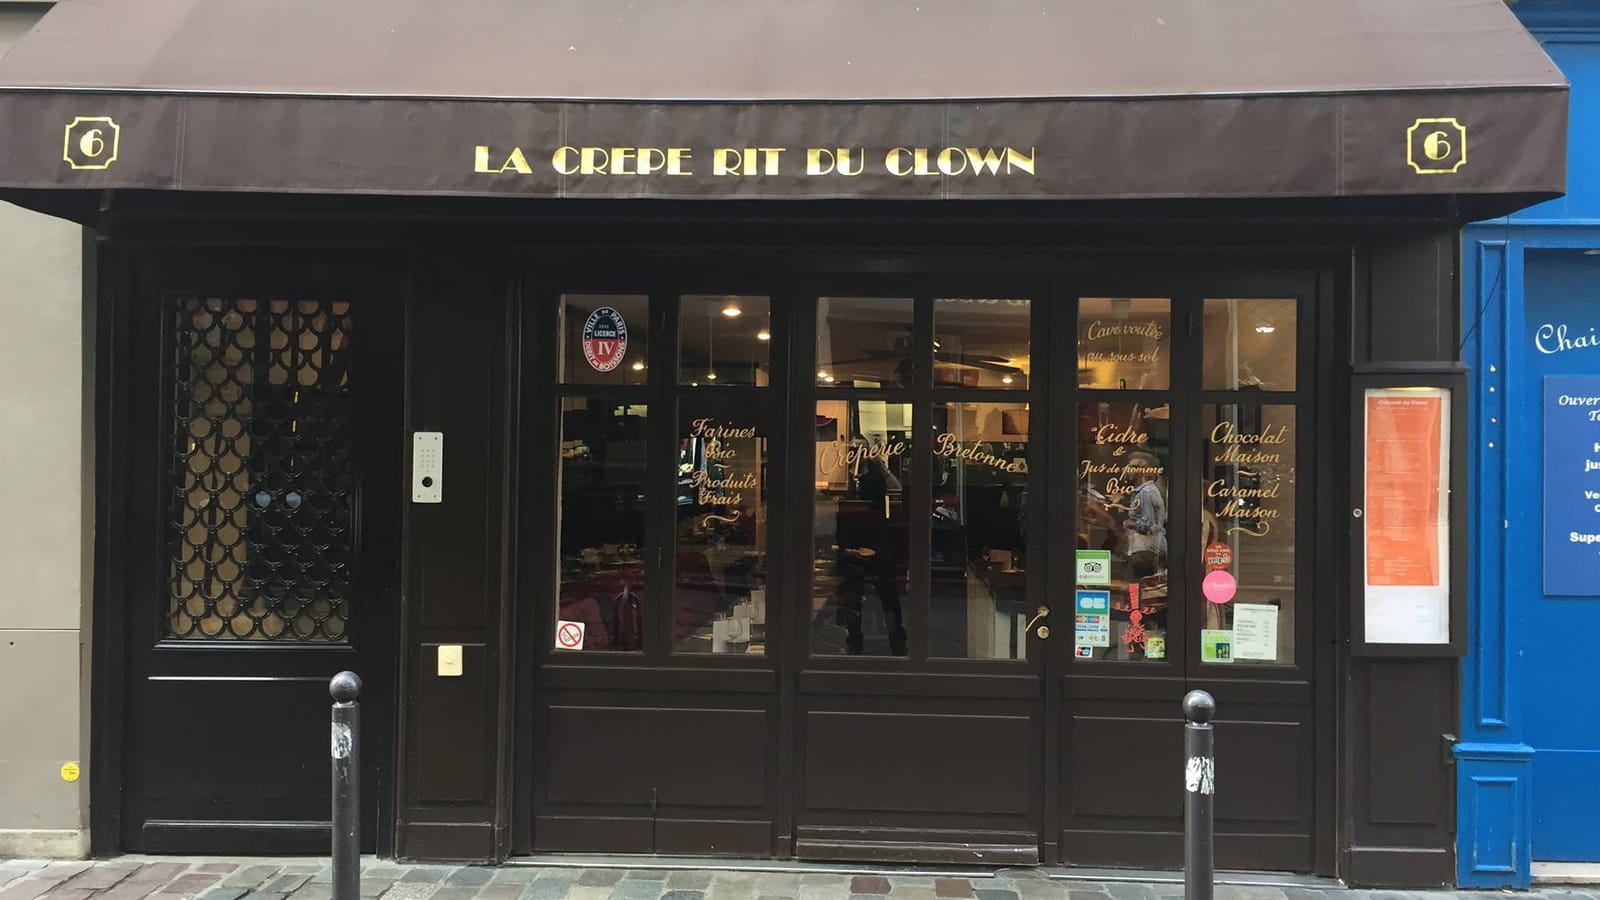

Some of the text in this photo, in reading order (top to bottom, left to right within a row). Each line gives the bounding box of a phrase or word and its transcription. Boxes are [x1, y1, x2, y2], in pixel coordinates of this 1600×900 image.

[80, 129, 104, 157] 6
[1424, 131, 1451, 160] 6
[474, 145, 1035, 177] LA CREPE RIT DU CLOWN
[585, 313, 600, 334] VILLE
[610, 312, 625, 334] PARIS
[1087, 320, 1122, 341] Cave
[597, 341, 615, 356] IV
[1087, 346, 1161, 362] au sous-sol
[690, 418, 756, 438] Farines
[1095, 423, 1149, 445] Cidre
[1211, 421, 1289, 444] Chocolat
[705, 440, 737, 459] Bio
[819, 432, 1018, 476] Crêperie Bretonne
[1112, 446, 1127, 456] &
[1214, 444, 1281, 463] Maison
[689, 470, 759, 489] Produits
[1079, 459, 1164, 481] Jus de pomme
[1106, 477, 1136, 495] Bio
[1207, 479, 1280, 498] Caramel
[699, 490, 743, 505] Frais
[1215, 500, 1280, 519] Maison
